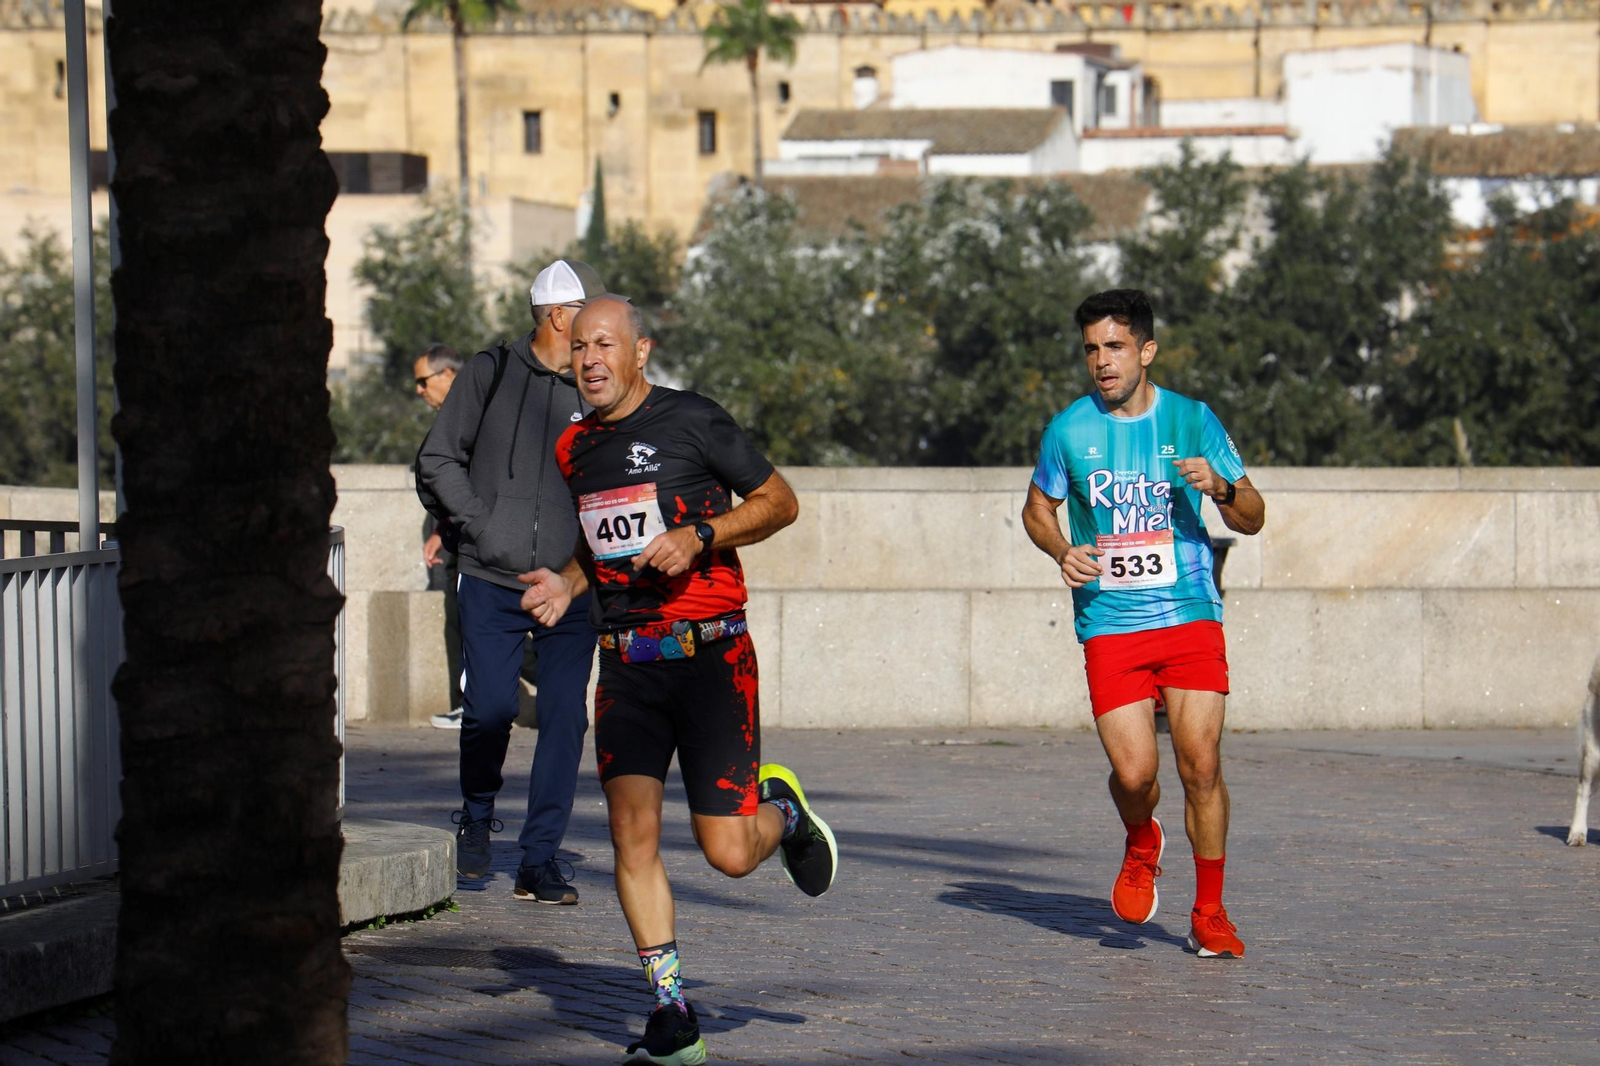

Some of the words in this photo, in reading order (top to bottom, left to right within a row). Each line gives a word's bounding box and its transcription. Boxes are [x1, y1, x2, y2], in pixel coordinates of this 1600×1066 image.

[1161, 445, 1175, 454] 25
[1086, 469, 1171, 509] Ruta
[596, 511, 647, 543] 407
[1112, 501, 1174, 535] Miel
[1111, 553, 1163, 578] 533
